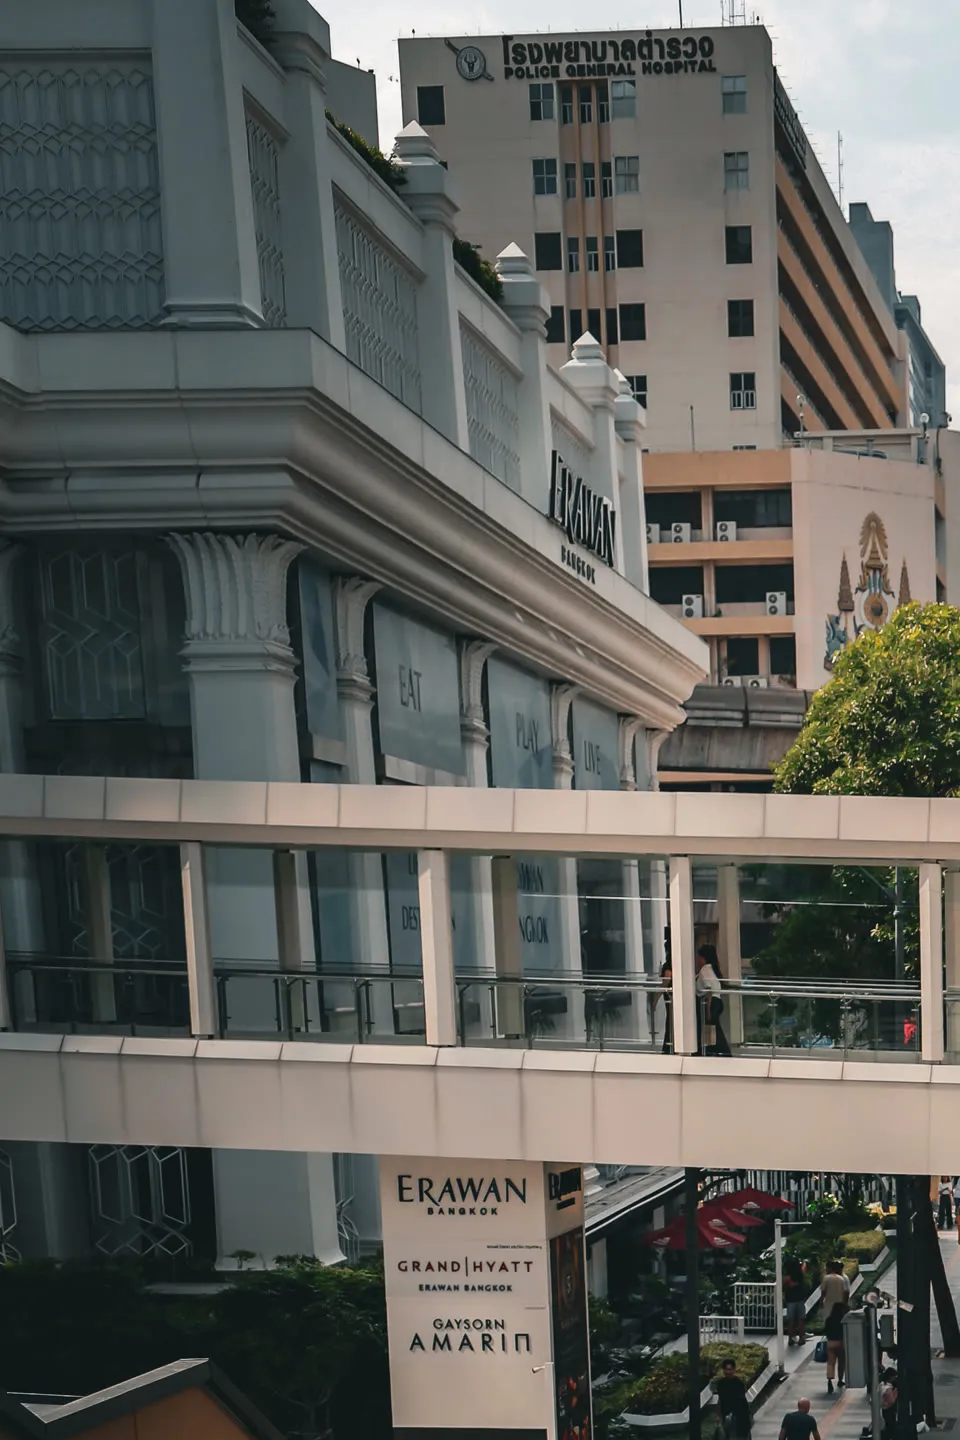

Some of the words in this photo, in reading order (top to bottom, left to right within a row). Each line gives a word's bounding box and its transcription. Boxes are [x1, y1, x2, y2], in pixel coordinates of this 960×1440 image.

[502, 30, 714, 66] โรงพยาบาลตำรวจ
[504, 64, 560, 80] POLICE
[566, 62, 636, 77] GENERAL
[642, 59, 717, 75] HOSPITAL
[549, 450, 616, 567] ERAWAN
[561, 545, 596, 585] BANGKOK
[398, 663, 421, 712] EAT
[515, 711, 539, 754] PLAY
[584, 740, 601, 775] LIVE
[397, 1174, 527, 1206] ERAWAN
[427, 1207, 498, 1216] BANGKOK
[397, 1260, 461, 1273] GRAND
[473, 1260, 533, 1273] HYATT
[418, 1283, 460, 1292] ERAWAN
[464, 1284, 513, 1292] BANGKOK
[432, 1318, 505, 1330] GAYSORN
